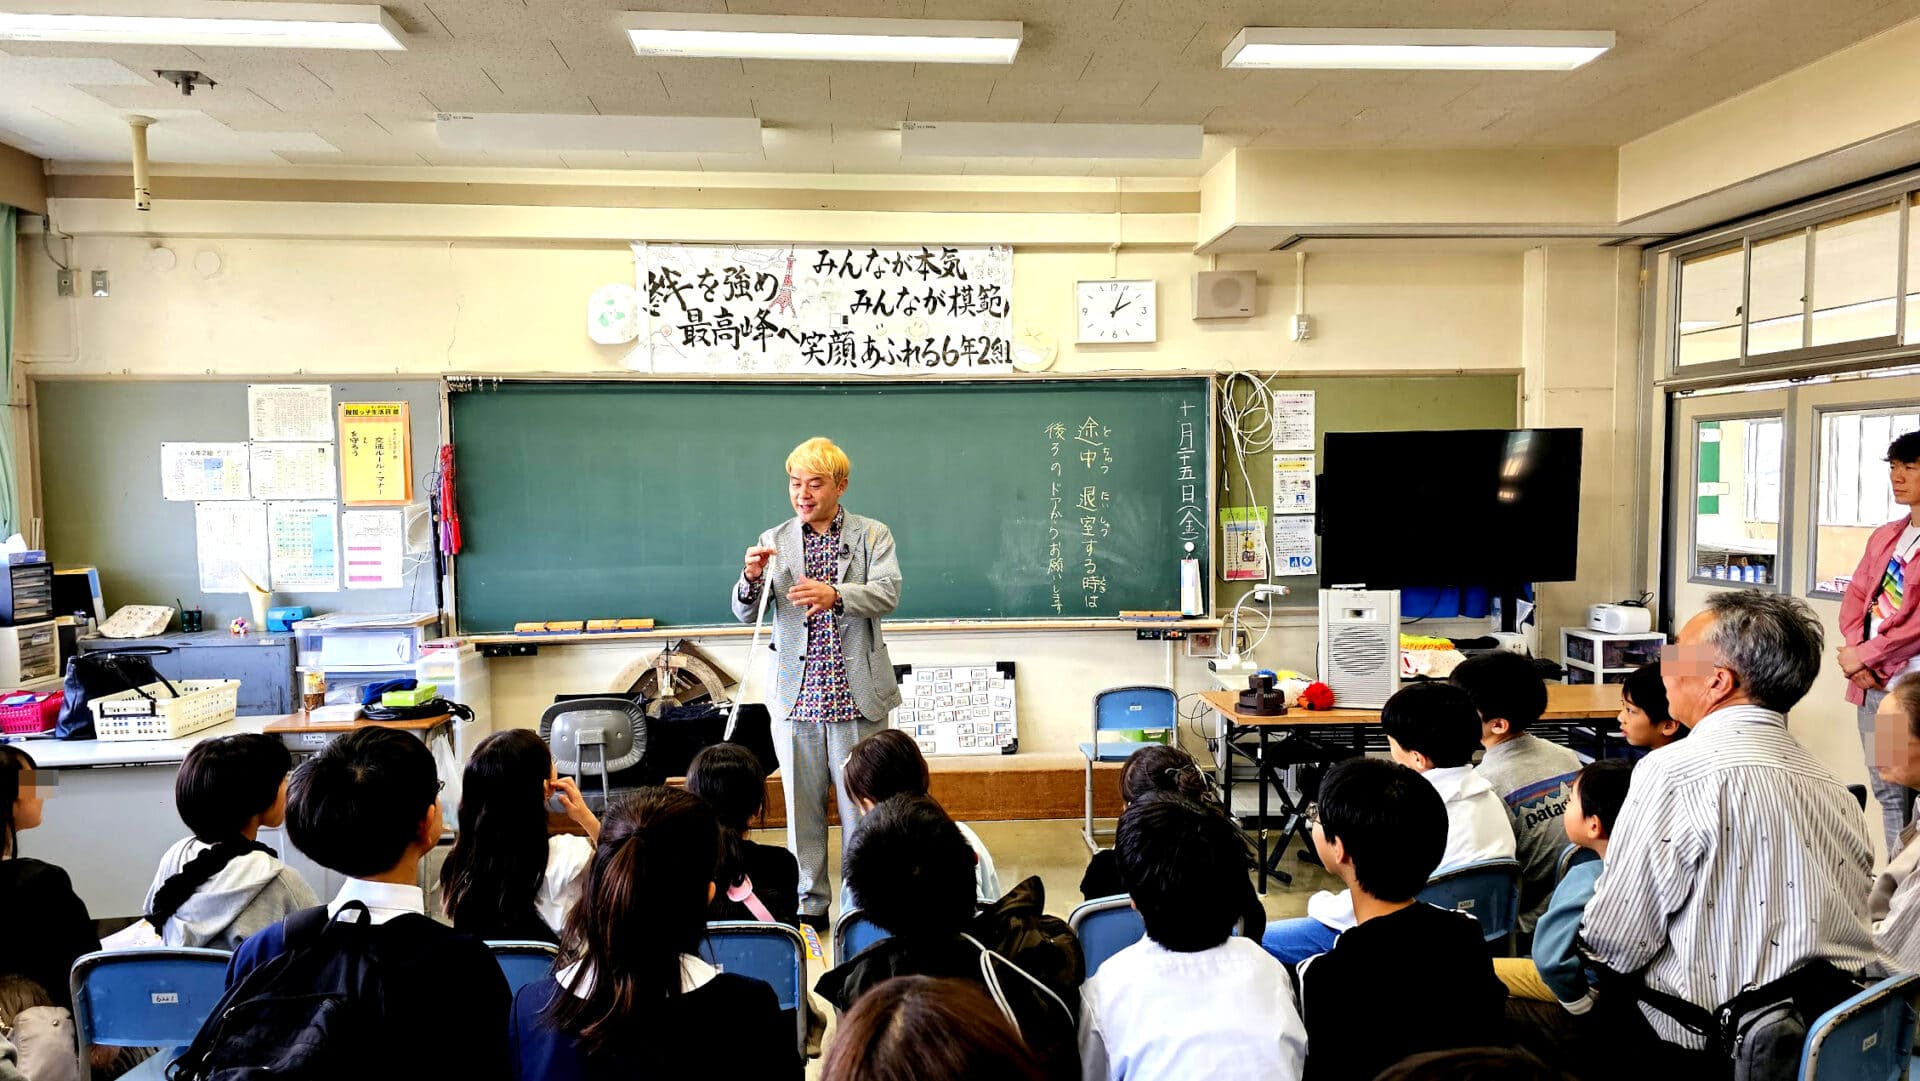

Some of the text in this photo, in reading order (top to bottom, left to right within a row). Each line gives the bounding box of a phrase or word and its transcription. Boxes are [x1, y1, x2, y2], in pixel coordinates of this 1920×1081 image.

[813, 246, 968, 280] みんなが本気
[849, 284, 1010, 318] みんなが模範
[1082, 307, 1088, 316] 9
[1141, 306, 1147, 315] 3
[676, 307, 800, 353] 最高峰へ
[1112, 330, 1118, 339] 6
